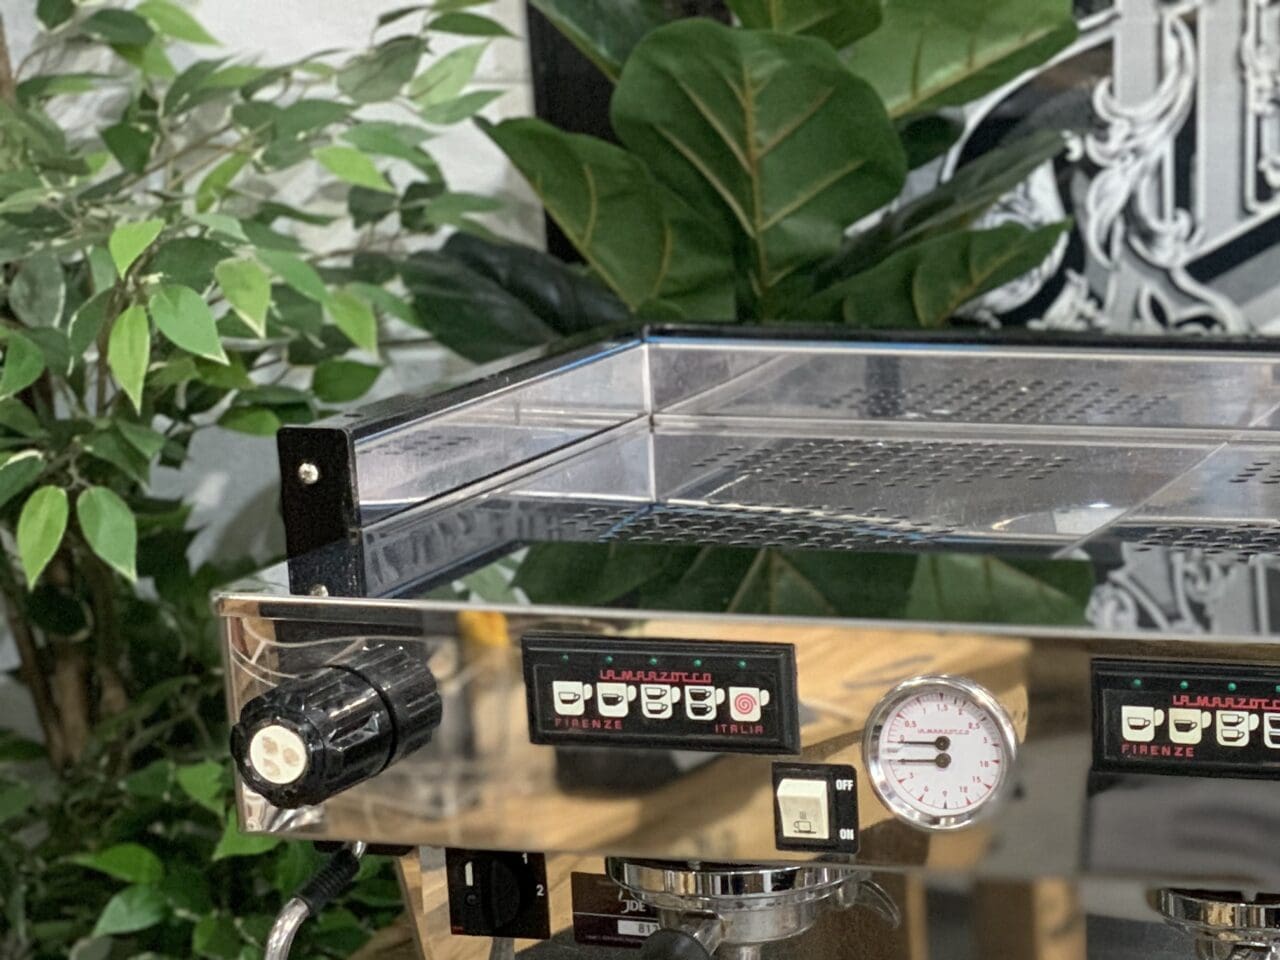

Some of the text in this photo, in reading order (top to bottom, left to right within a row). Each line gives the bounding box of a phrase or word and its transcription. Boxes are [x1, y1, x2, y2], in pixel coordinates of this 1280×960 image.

[554, 718, 764, 735] FIRENZE ITALIA
[1121, 743, 1195, 758] FIRENZE
[835, 779, 854, 791] OFF
[839, 828, 855, 841] ON
[521, 852, 529, 865] 1
[535, 884, 545, 897] 2
[620, 899, 647, 914] JDE
